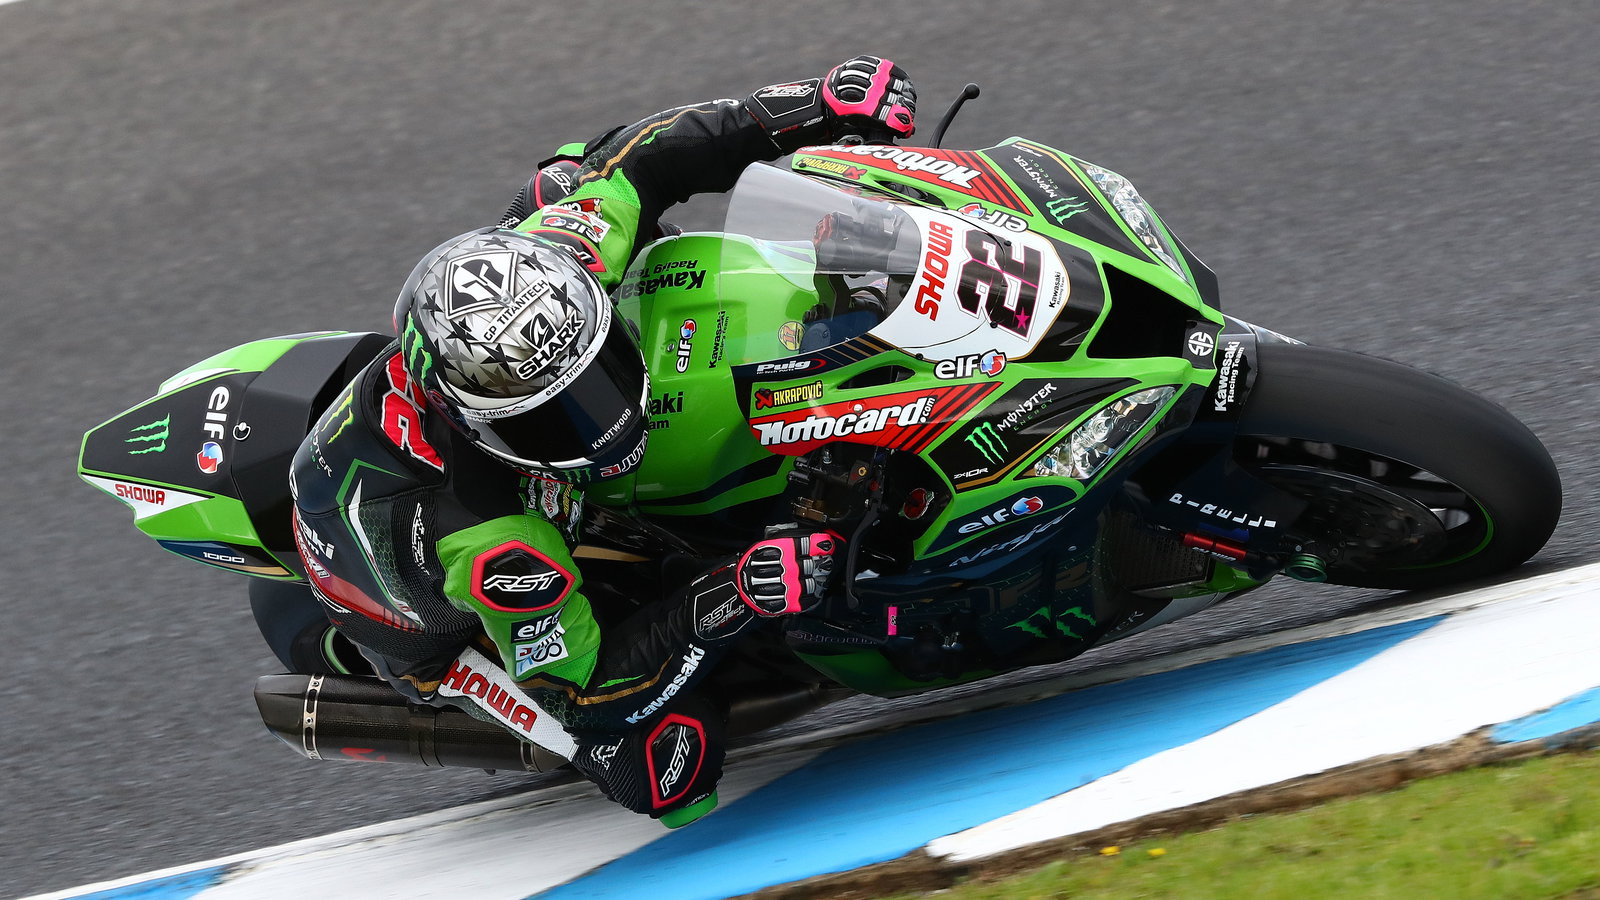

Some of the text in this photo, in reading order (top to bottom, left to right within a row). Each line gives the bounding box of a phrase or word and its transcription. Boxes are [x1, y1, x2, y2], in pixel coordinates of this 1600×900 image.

[983, 212, 1029, 233] elf
[914, 221, 953, 321] SHOWA
[954, 227, 1044, 342] 22
[1049, 271, 1062, 308] Kawasaki
[482, 279, 548, 341] GP TITANTECH
[516, 311, 585, 380] SHARK
[676, 339, 693, 374] elf
[708, 310, 727, 369] Kawasaki
[545, 361, 585, 397] easy-trim
[757, 359, 811, 371] Puig
[934, 356, 979, 378] elf
[1215, 341, 1240, 412] Kawasaki
[1227, 346, 1245, 403] Racing Team
[203, 385, 230, 440] elf
[996, 382, 1058, 432] MONSTER
[591, 408, 632, 449] KNOTWOOD
[115, 483, 165, 506] SHOWA
[1169, 492, 1277, 528] PIRELLI
[958, 508, 1010, 535] elf
[203, 551, 245, 564] 1000
[483, 570, 562, 593] RST
[517, 615, 553, 638] elf
[699, 594, 738, 632] RST
[440, 659, 538, 733] HOWA
[625, 643, 706, 725] Kawasaki
[659, 726, 691, 797] RST
